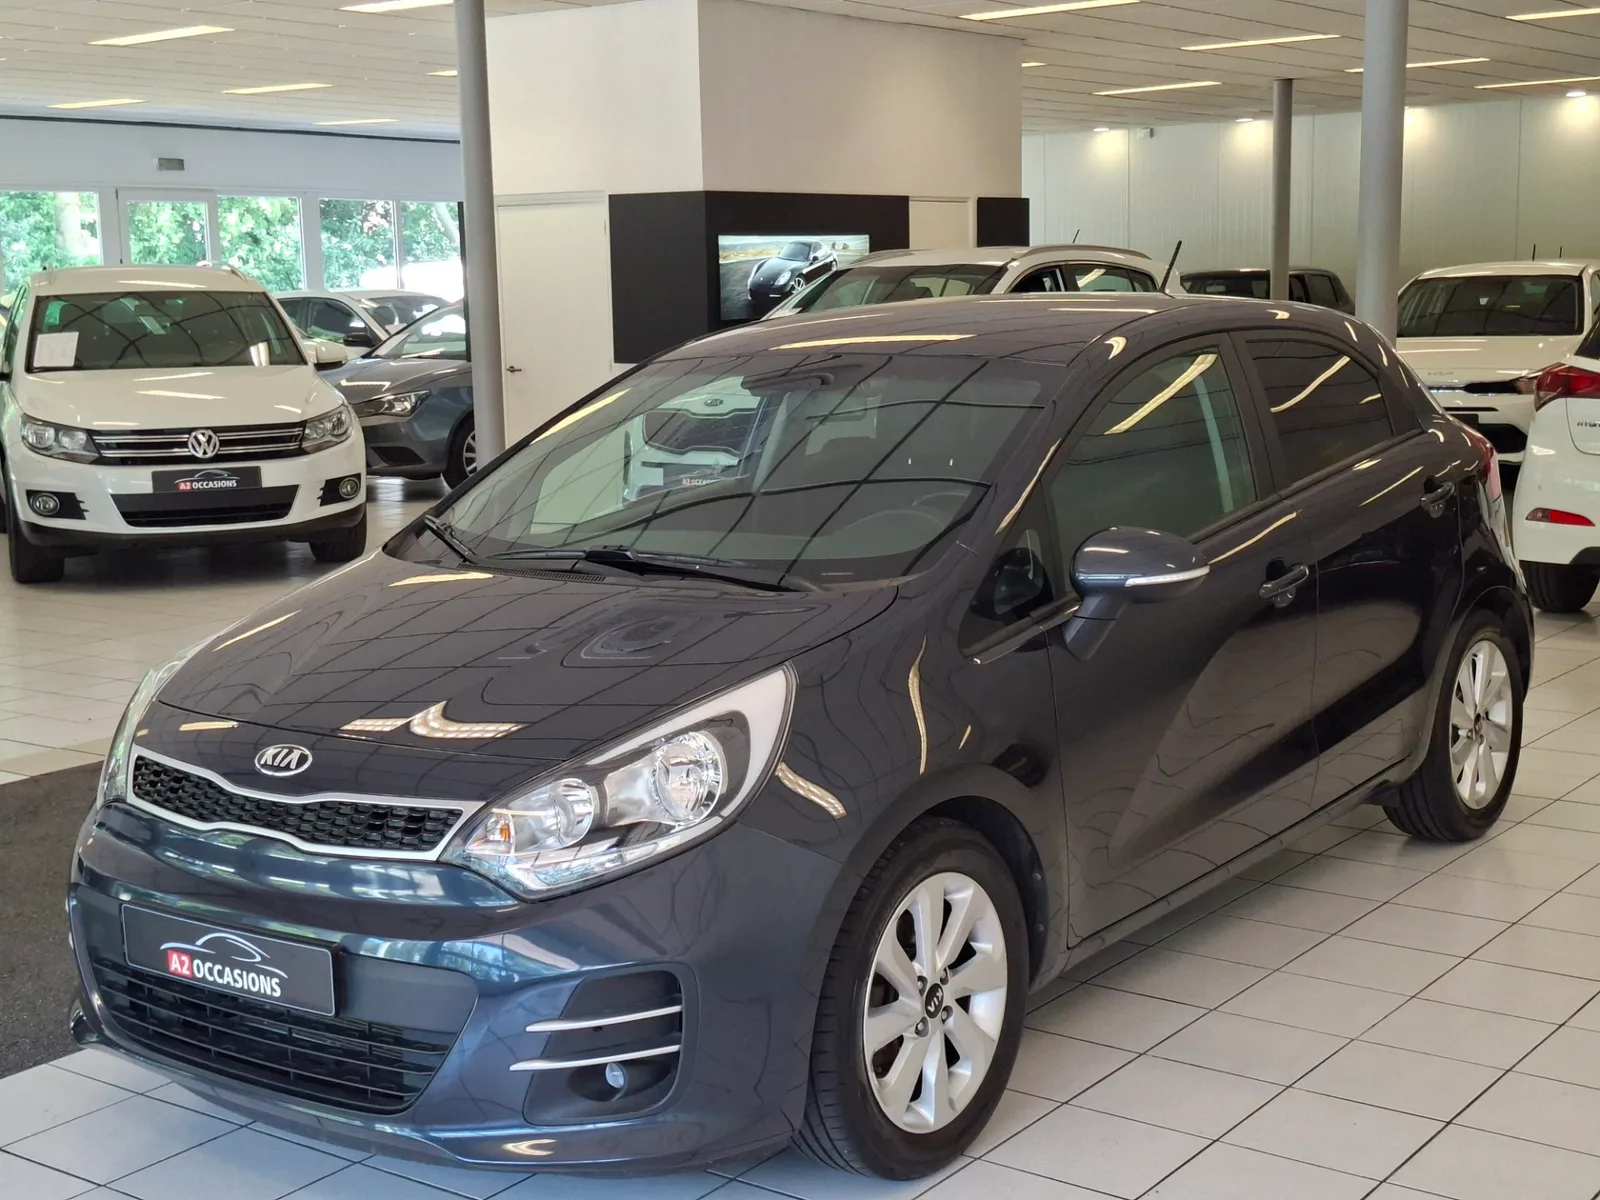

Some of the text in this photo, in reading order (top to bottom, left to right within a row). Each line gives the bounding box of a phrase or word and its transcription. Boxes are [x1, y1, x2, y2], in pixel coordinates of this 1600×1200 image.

[180, 480, 237, 490] A2 OCCASIONS
[259, 747, 303, 770] KIA
[170, 953, 282, 997] A2 OCCASIONS
